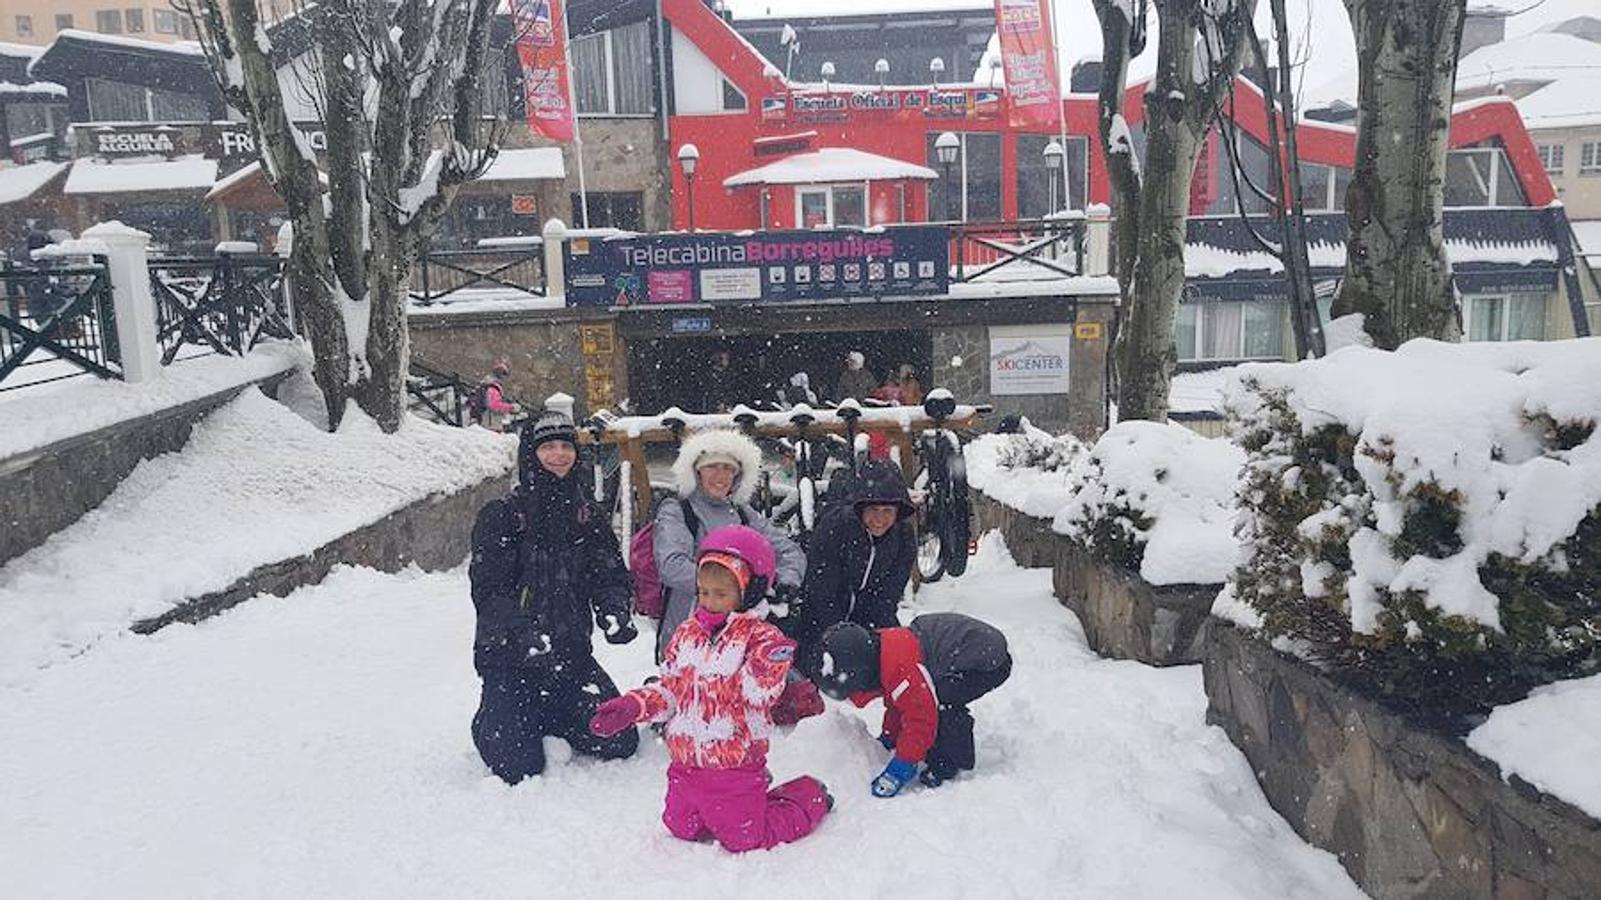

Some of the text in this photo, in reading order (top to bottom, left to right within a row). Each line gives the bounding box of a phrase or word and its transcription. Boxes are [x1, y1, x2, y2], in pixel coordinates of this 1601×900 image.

[793, 97, 846, 111] Escuela
[850, 93, 899, 108] Oficial
[904, 94, 923, 106] de
[98, 133, 169, 144] ESCUELA
[98, 143, 174, 152] ALQUILER
[996, 357, 1063, 371] SKICENTER
